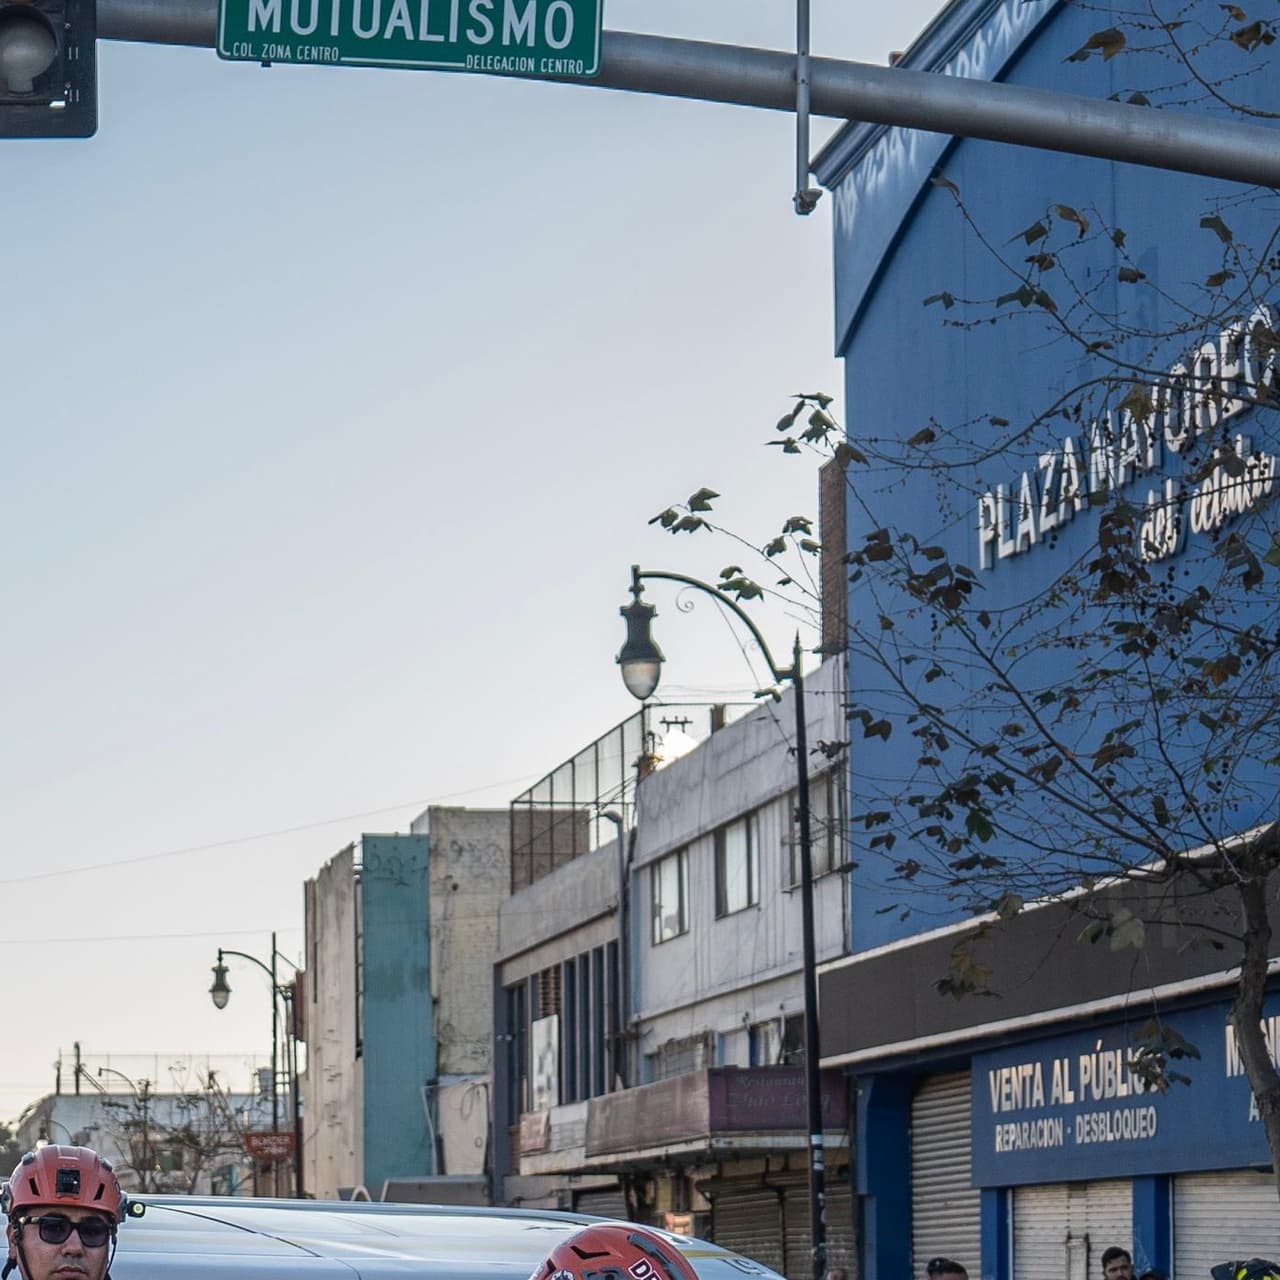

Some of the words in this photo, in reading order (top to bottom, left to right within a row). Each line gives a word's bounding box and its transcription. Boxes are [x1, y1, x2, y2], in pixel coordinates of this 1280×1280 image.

[246, 0, 575, 50] MUTUALISMO
[262, 44, 292, 60] ZONA
[297, 46, 340, 62] CENTRO
[466, 54, 535, 72] DELEGACION
[540, 58, 584, 74] CENTRO
[978, 436, 1086, 570] PLAZA
[1090, 303, 1280, 495] MAYOREO
[1141, 478, 1184, 564] del
[989, 1061, 1045, 1114] VENTA
[1051, 1057, 1075, 1106] AL
[995, 1117, 1064, 1153] REPARACION
[1076, 1105, 1157, 1145] DESBLOQUEO
